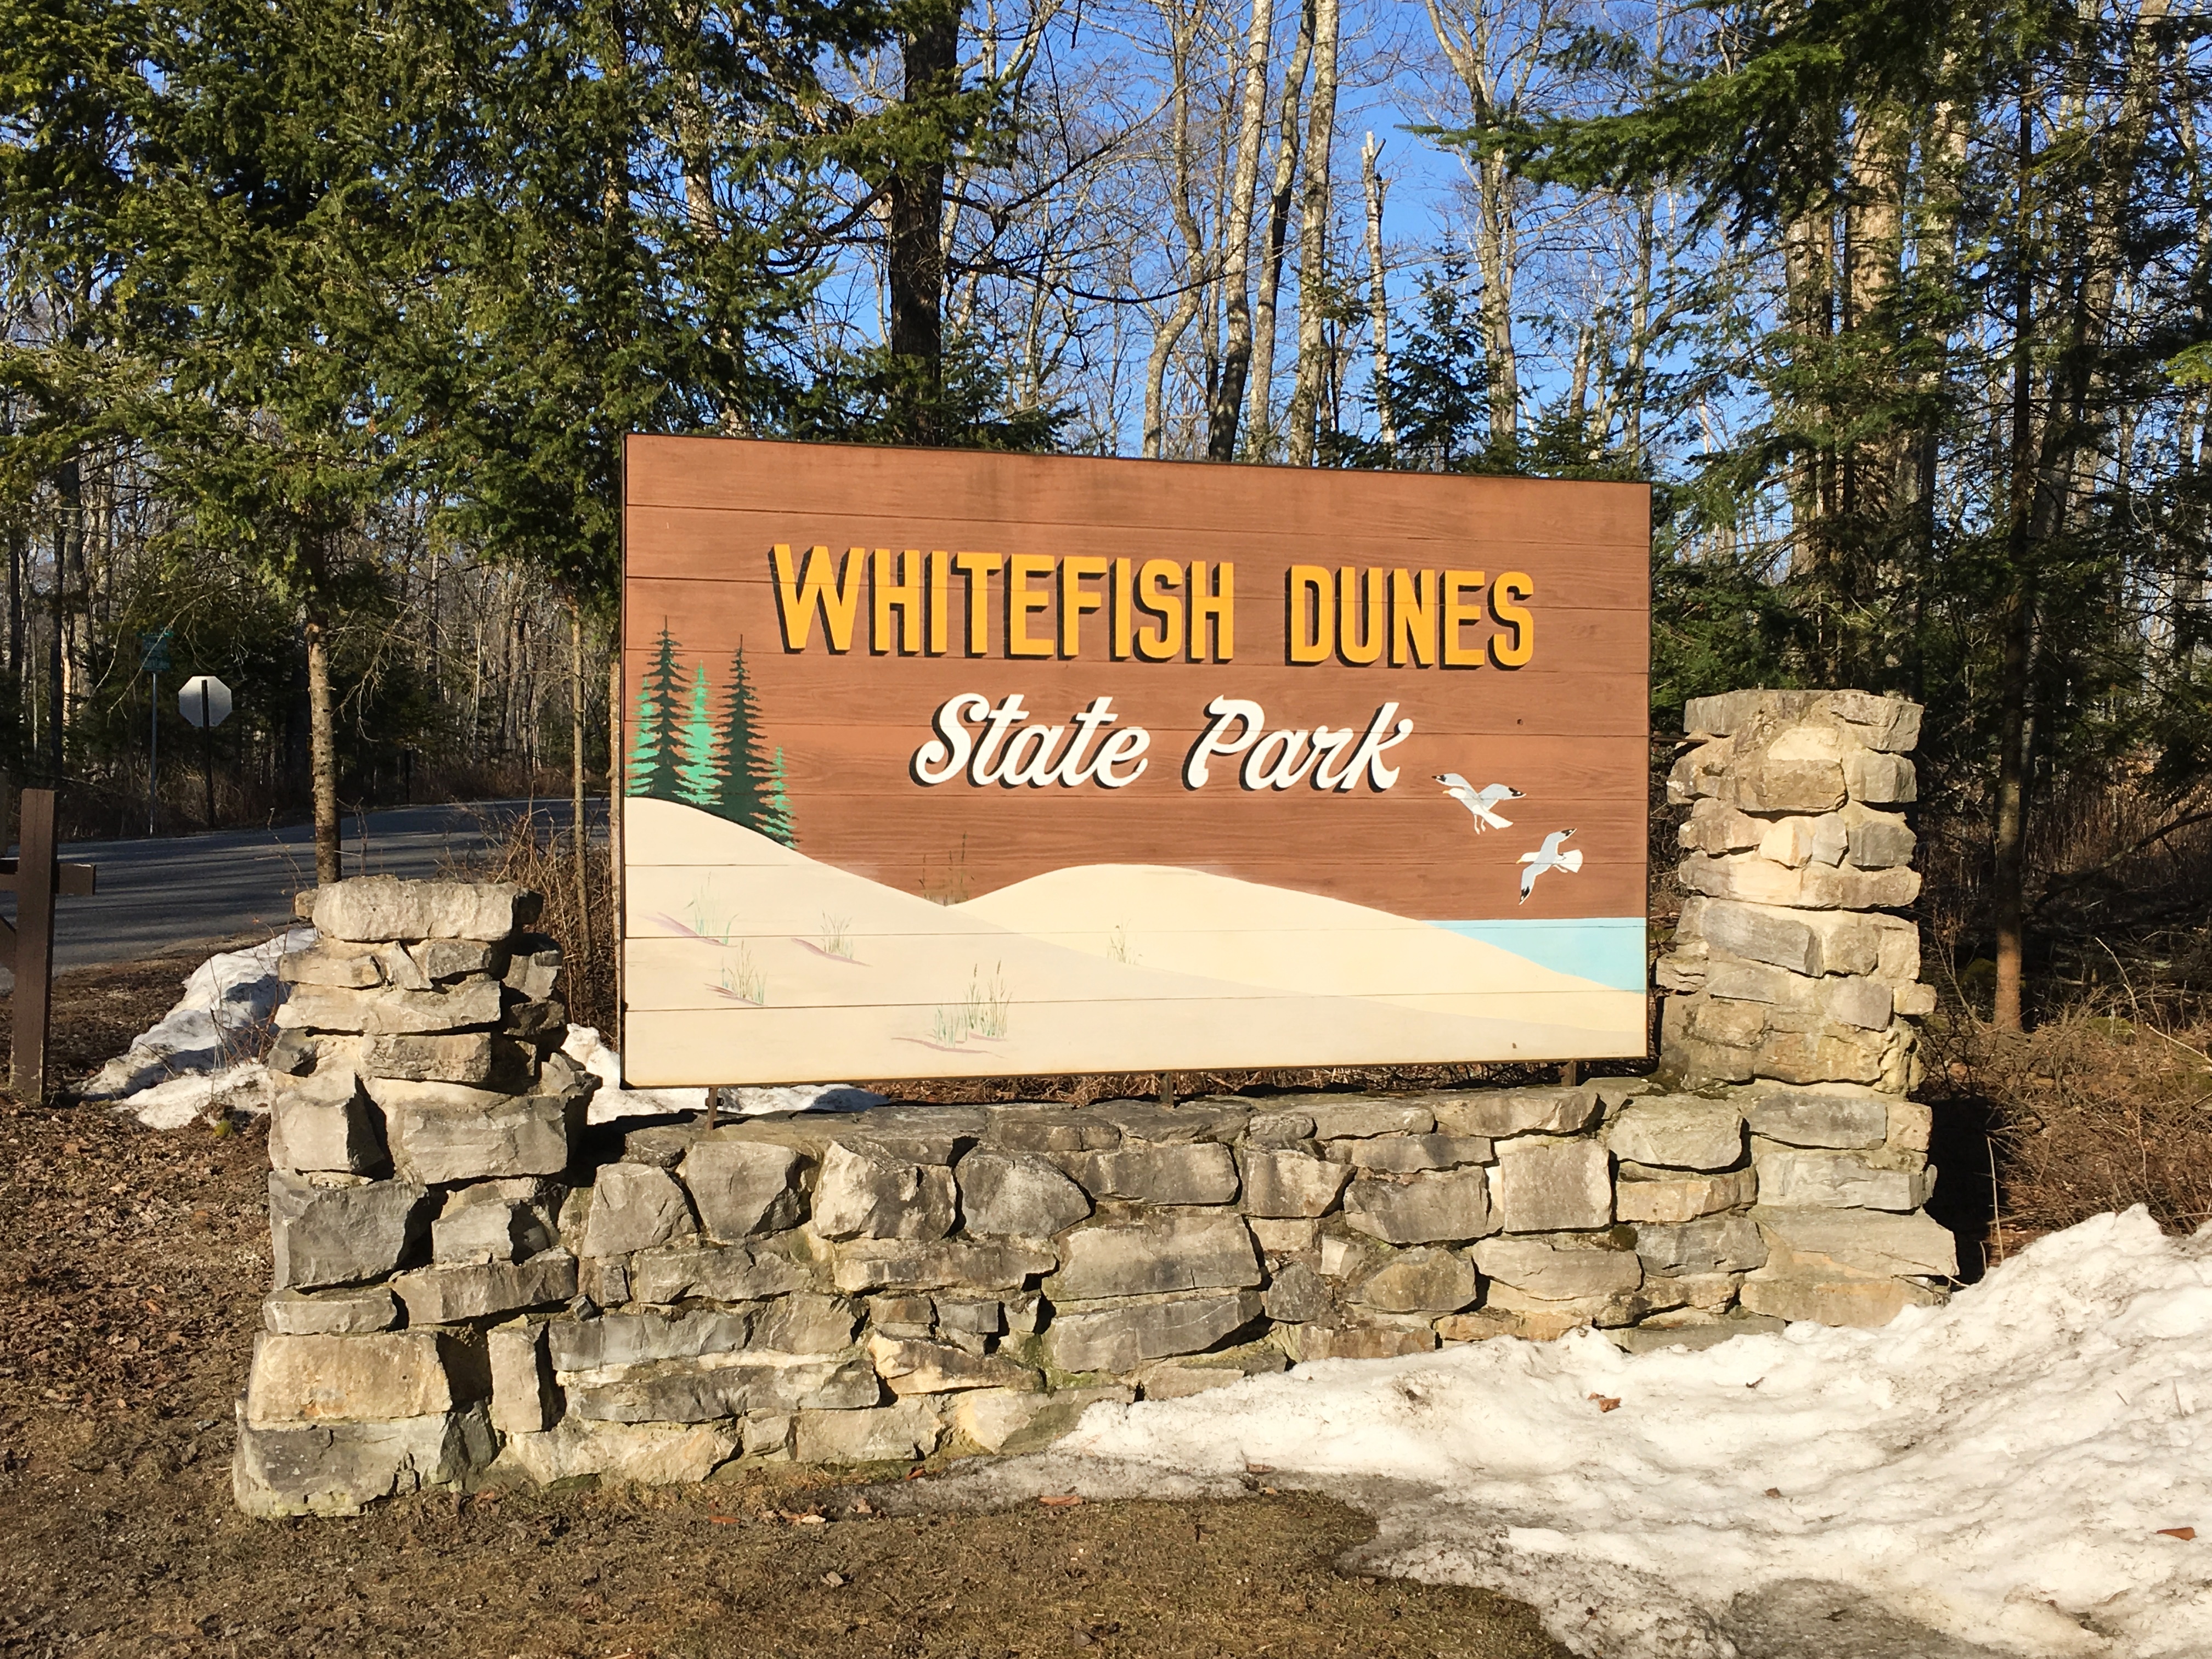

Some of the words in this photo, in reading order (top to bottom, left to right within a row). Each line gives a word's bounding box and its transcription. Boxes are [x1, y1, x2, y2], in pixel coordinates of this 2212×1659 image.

[769, 544, 1234, 663] WHITEFISH
[1286, 564, 1535, 670] DUNES
[910, 693, 1150, 789] State
[1182, 695, 1414, 792] Park
